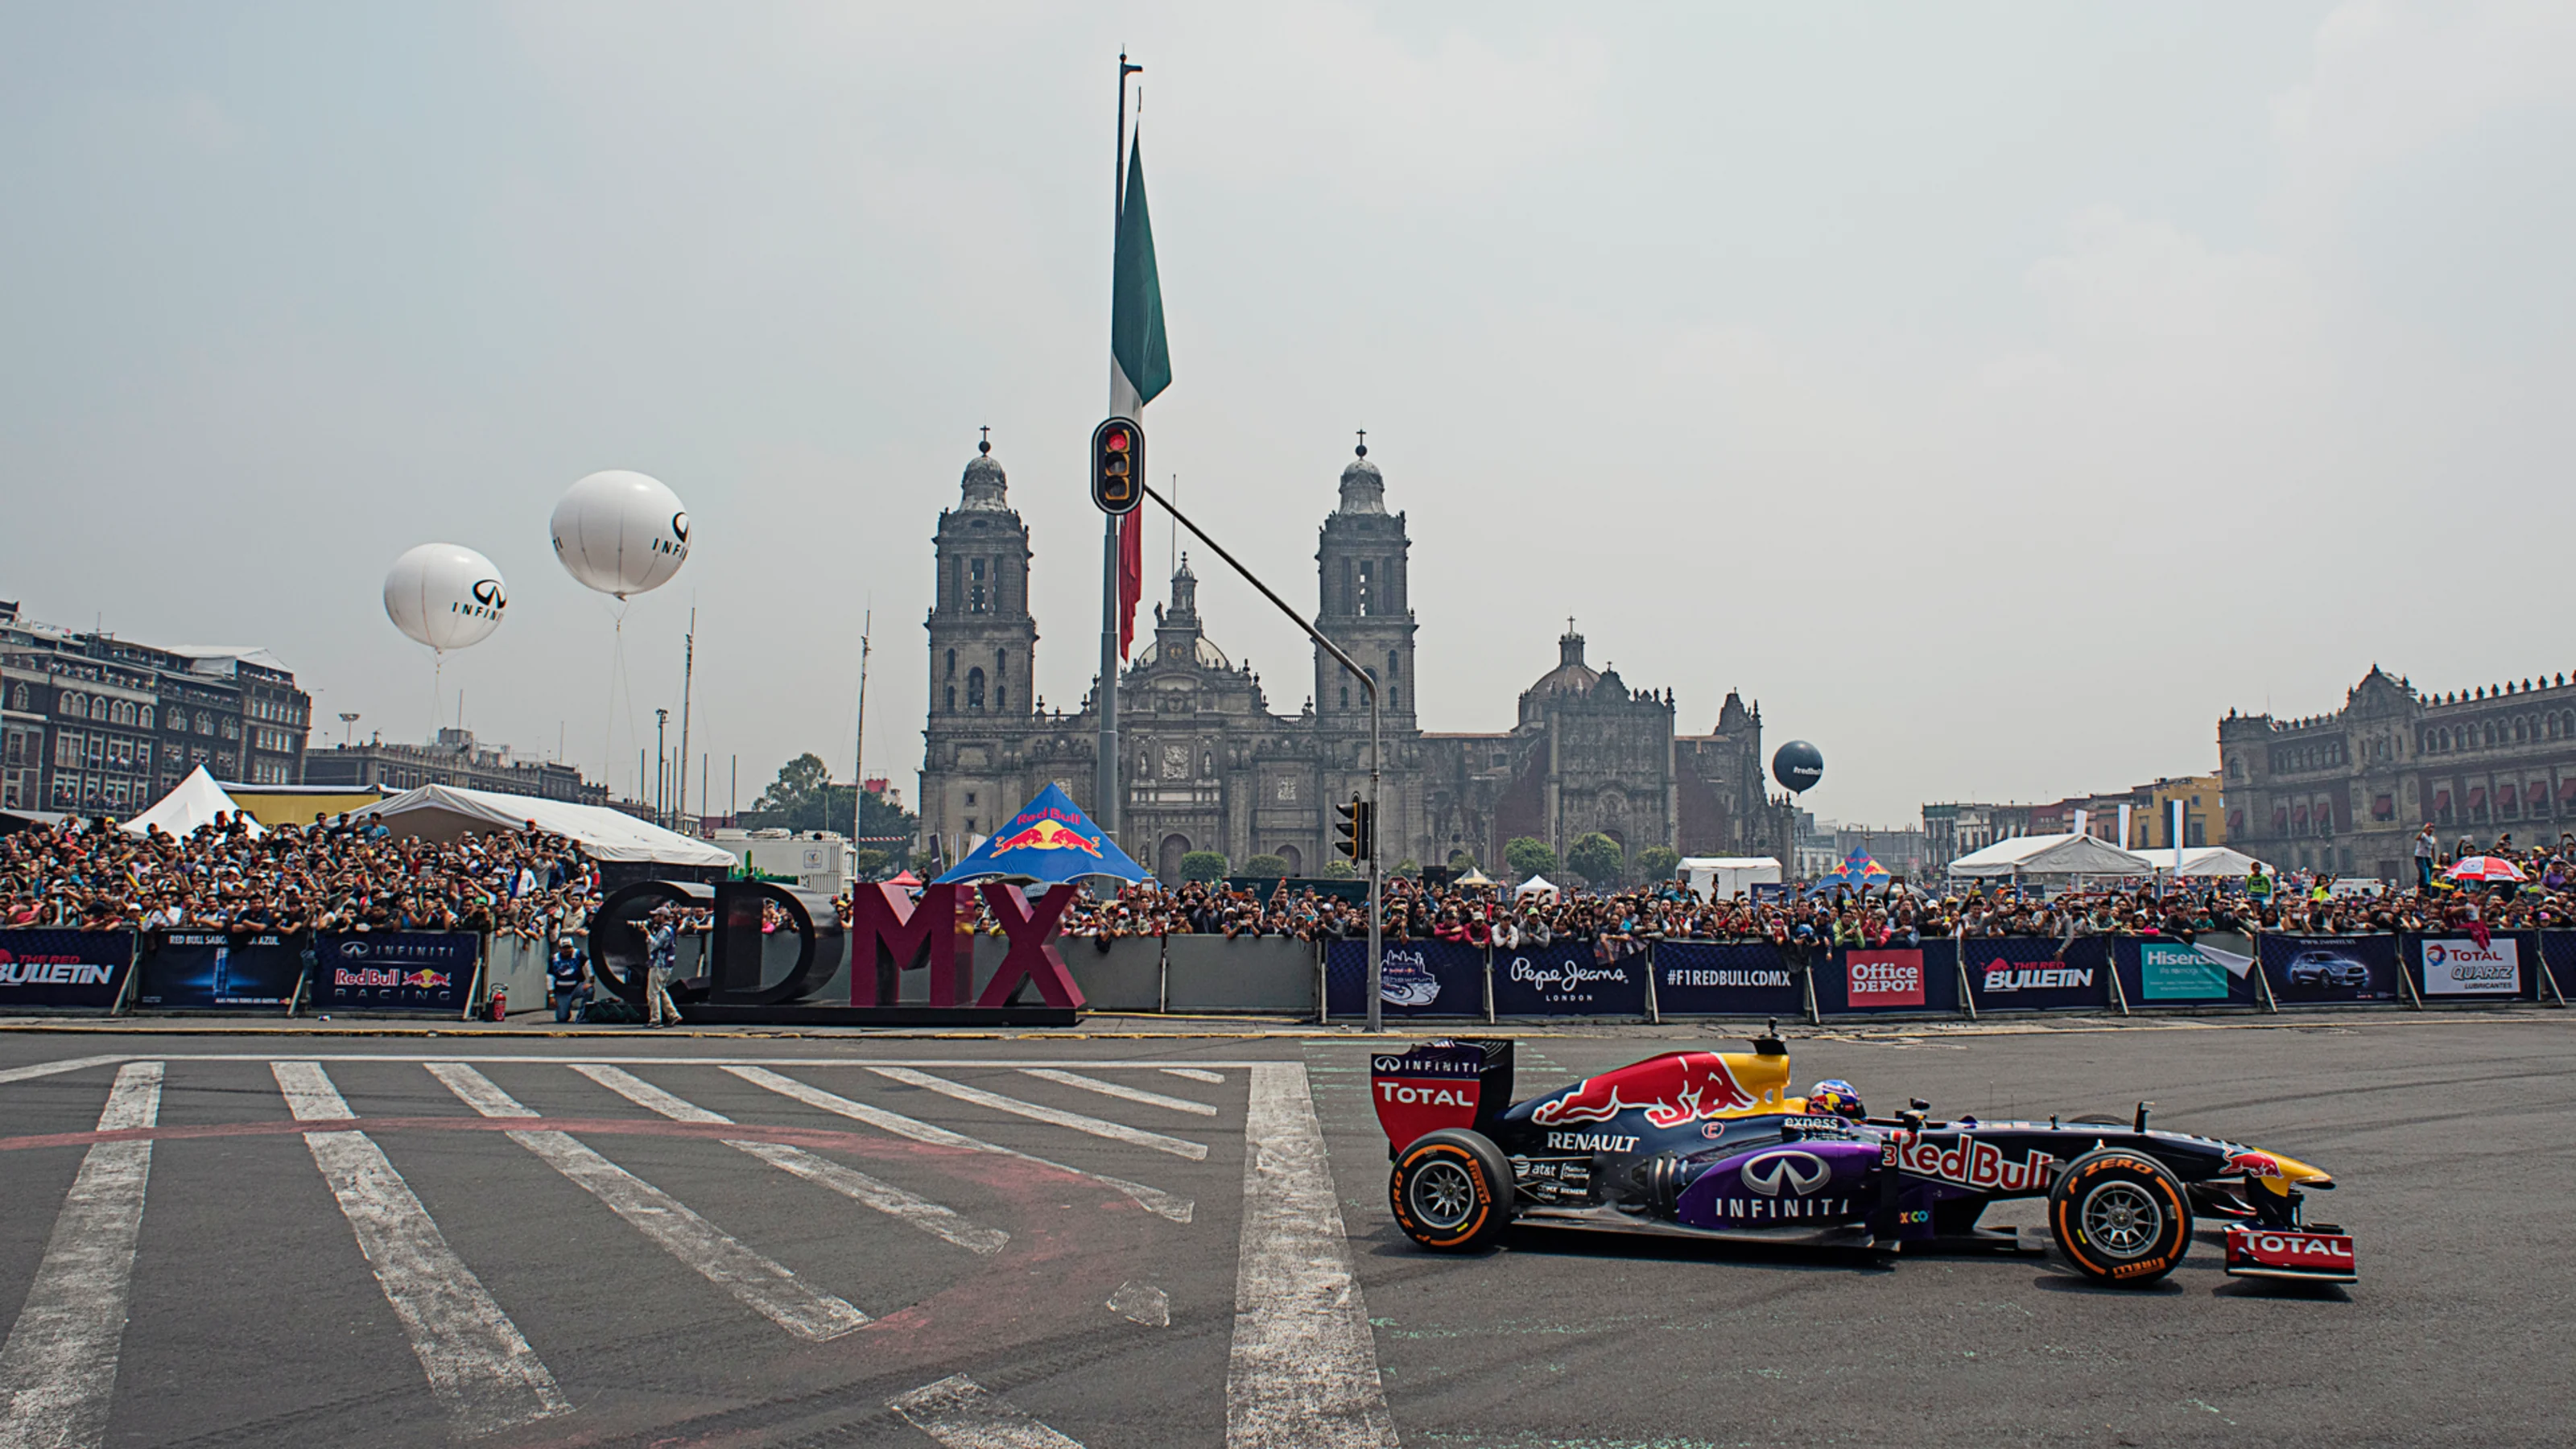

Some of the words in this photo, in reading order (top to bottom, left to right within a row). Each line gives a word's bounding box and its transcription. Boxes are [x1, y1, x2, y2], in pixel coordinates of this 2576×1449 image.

[1017, 807, 1048, 825] Red
[1050, 807, 1080, 825] Bull
[168, 935, 185, 944] RED
[186, 935, 204, 944] BULL
[258, 935, 280, 945] AZUL
[588, 880, 1087, 1007] CDMX
[19, 955, 47, 964] THE
[49, 956, 80, 964] RED
[375, 945, 454, 957] INFINITI
[2450, 949, 2504, 961] TOTAL
[1510, 956, 1563, 991] Pepe
[1561, 960, 1626, 991] Jeans
[1852, 963, 1918, 980] Office
[2013, 962, 2038, 970] THE
[2450, 965, 2513, 980] QUARTZ
[334, 968, 368, 985] Red
[368, 968, 400, 986] Bull
[1667, 969, 1791, 986] #F1REDBULLCDMX
[335, 989, 451, 1001] RACING
[1852, 980, 1919, 993] DEPOT
[1405, 1060, 1477, 1072] INFINITI
[1377, 1082, 1474, 1107] TOTAL
[1707, 1123, 1719, 1137] E
[1784, 1117, 1839, 1129] exness
[1547, 1132, 1640, 1152] RENAULT
[1882, 1144, 1897, 1166] 3
[1893, 1131, 1971, 1183] Red
[1968, 1140, 2054, 1191] Bull
[1531, 1163, 1557, 1177] at&t
[2084, 1158, 2153, 1178] ZERO
[1467, 1158, 1492, 1204] PIRELLI
[1393, 1170, 1414, 1228] ZERO
[1715, 1198, 1849, 1218] INFINITI
[2240, 1232, 2351, 1257] TOTAL
[2112, 1257, 2166, 1279] PIRELLI
